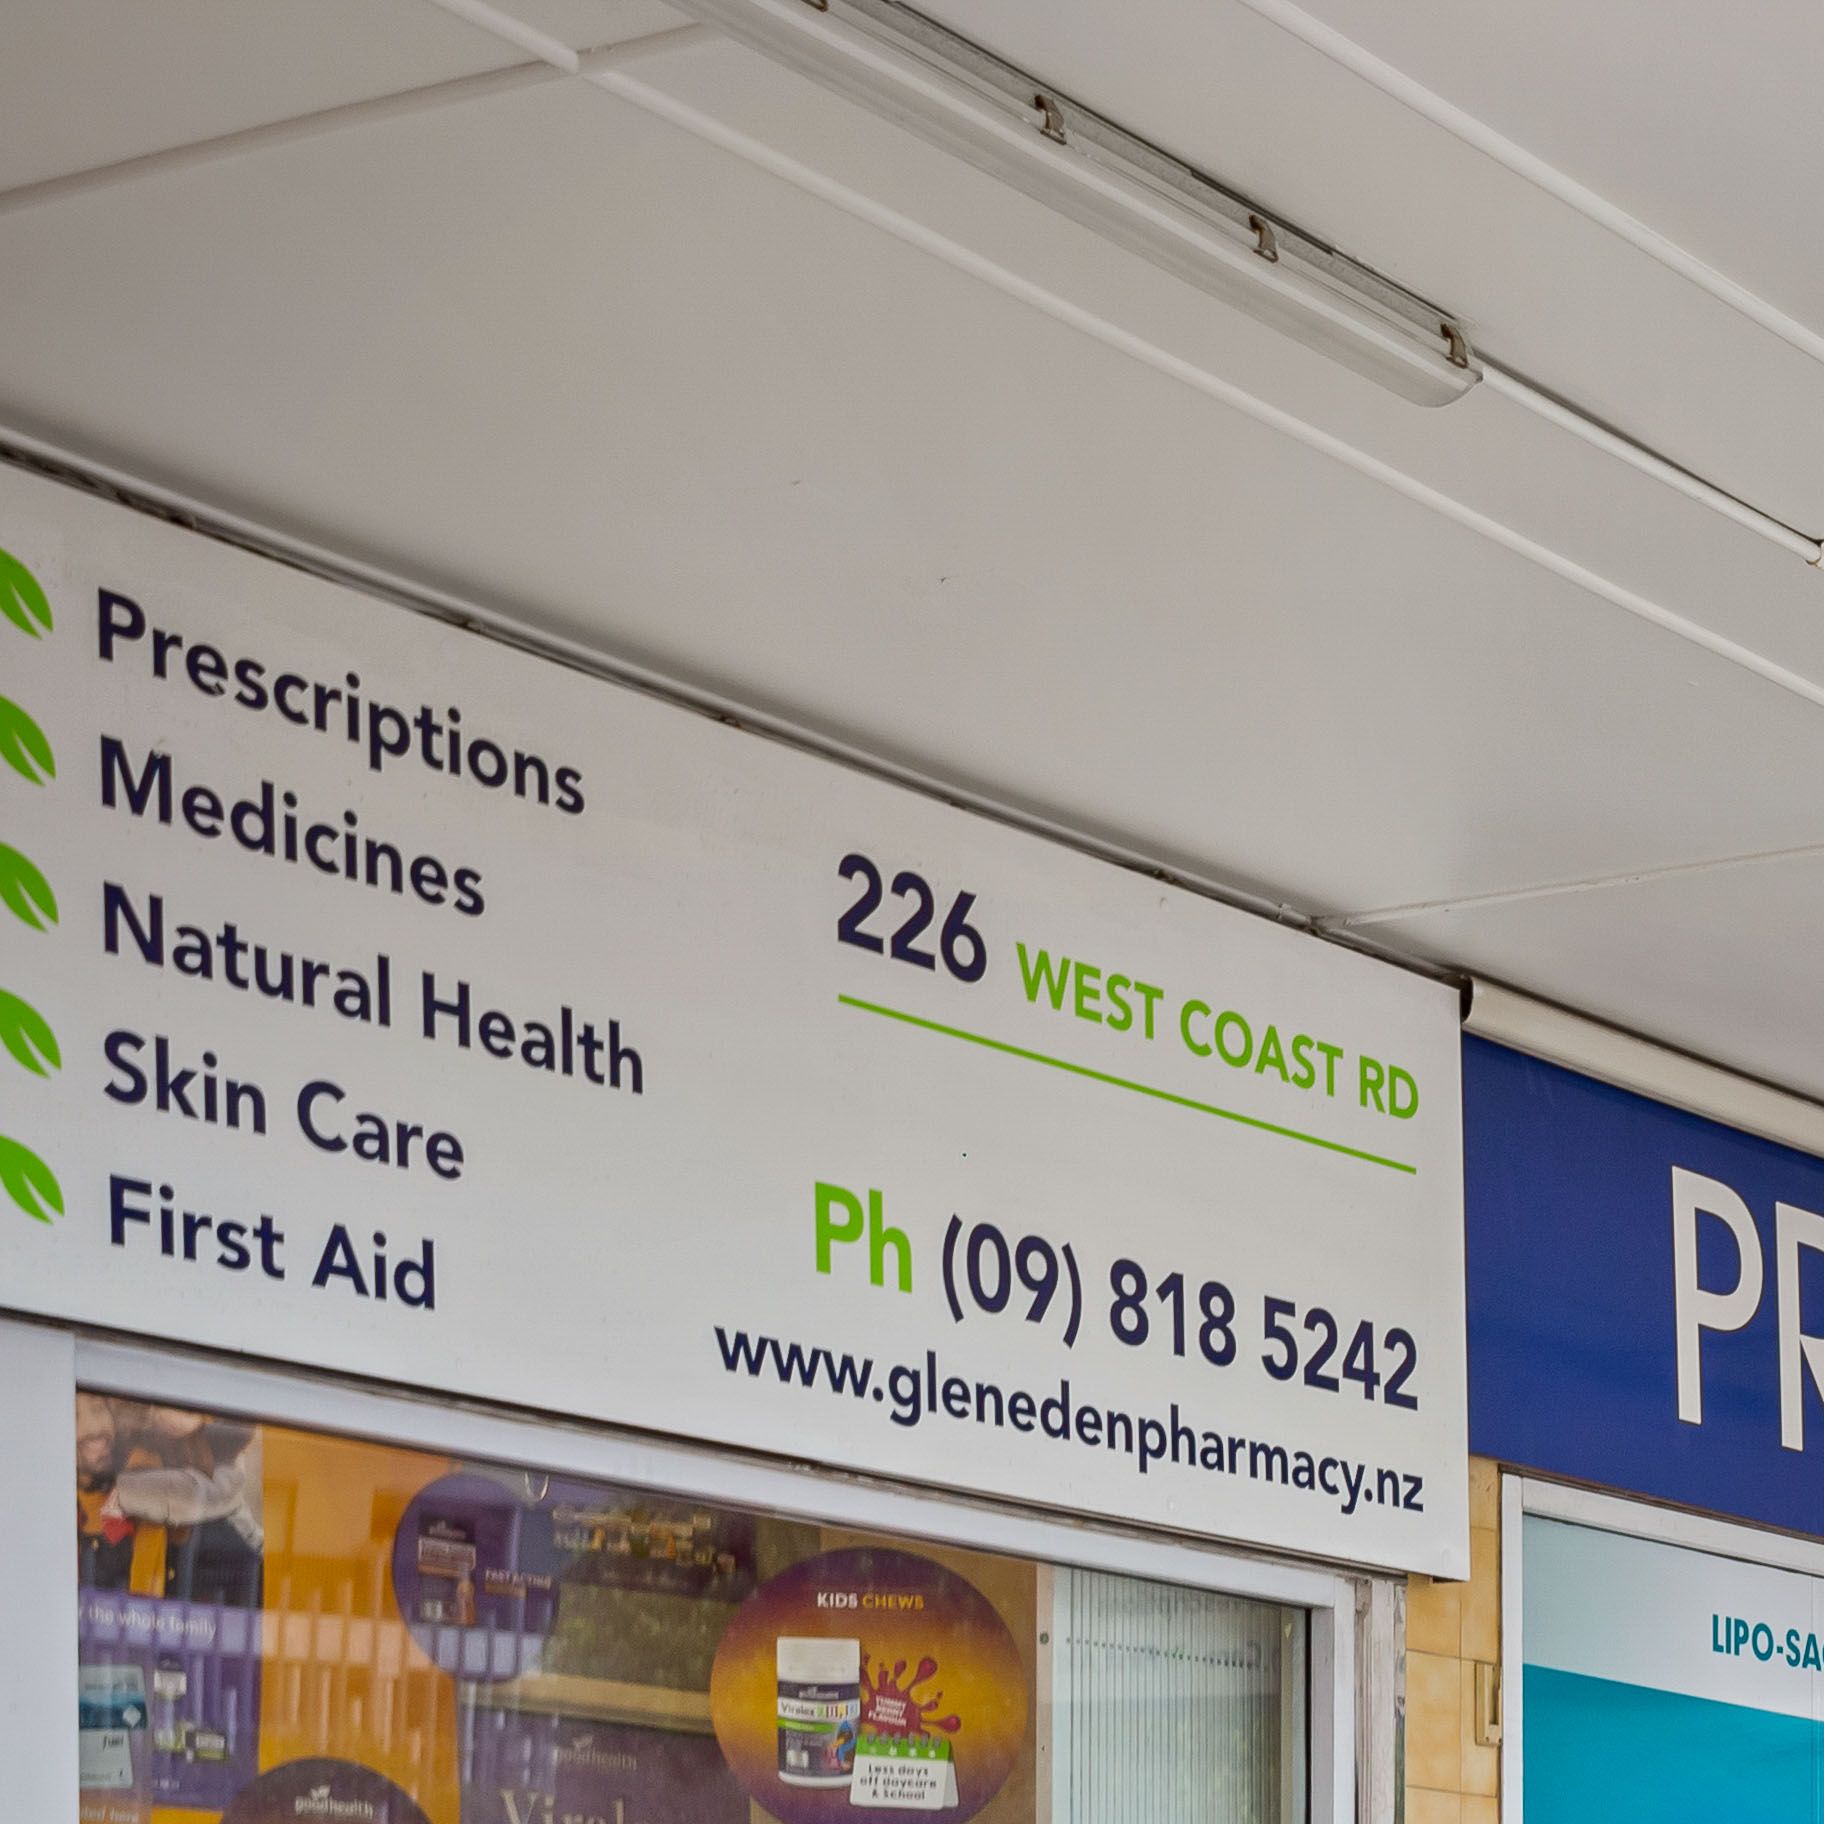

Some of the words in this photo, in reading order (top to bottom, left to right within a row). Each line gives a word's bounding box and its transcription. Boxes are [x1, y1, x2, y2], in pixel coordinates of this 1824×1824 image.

[97, 586, 586, 817] Prescriptions
[100, 733, 485, 919] Medicines
[103, 882, 391, 1028] Natural
[421, 965, 645, 1095] Health
[836, 851, 988, 983] 226
[1016, 939, 1164, 1037] WEST
[1179, 998, 1343, 1097] COAST
[1358, 1056, 1419, 1121] RD
[104, 1030, 267, 1137] Skin
[296, 1081, 465, 1180] Care
[108, 1173, 286, 1280] First
[312, 1222, 437, 1311] Aid
[814, 1181, 913, 1293] Ph
[940, 1211, 1083, 1347] (09)
[1109, 1260, 1237, 1370] 818
[1260, 1302, 1419, 1411] 5242
[714, 1322, 1425, 1514] www.glenedenpharmacy.nz
[816, 1591, 858, 1609] KIDS
[862, 1592, 925, 1611] CHEWS
